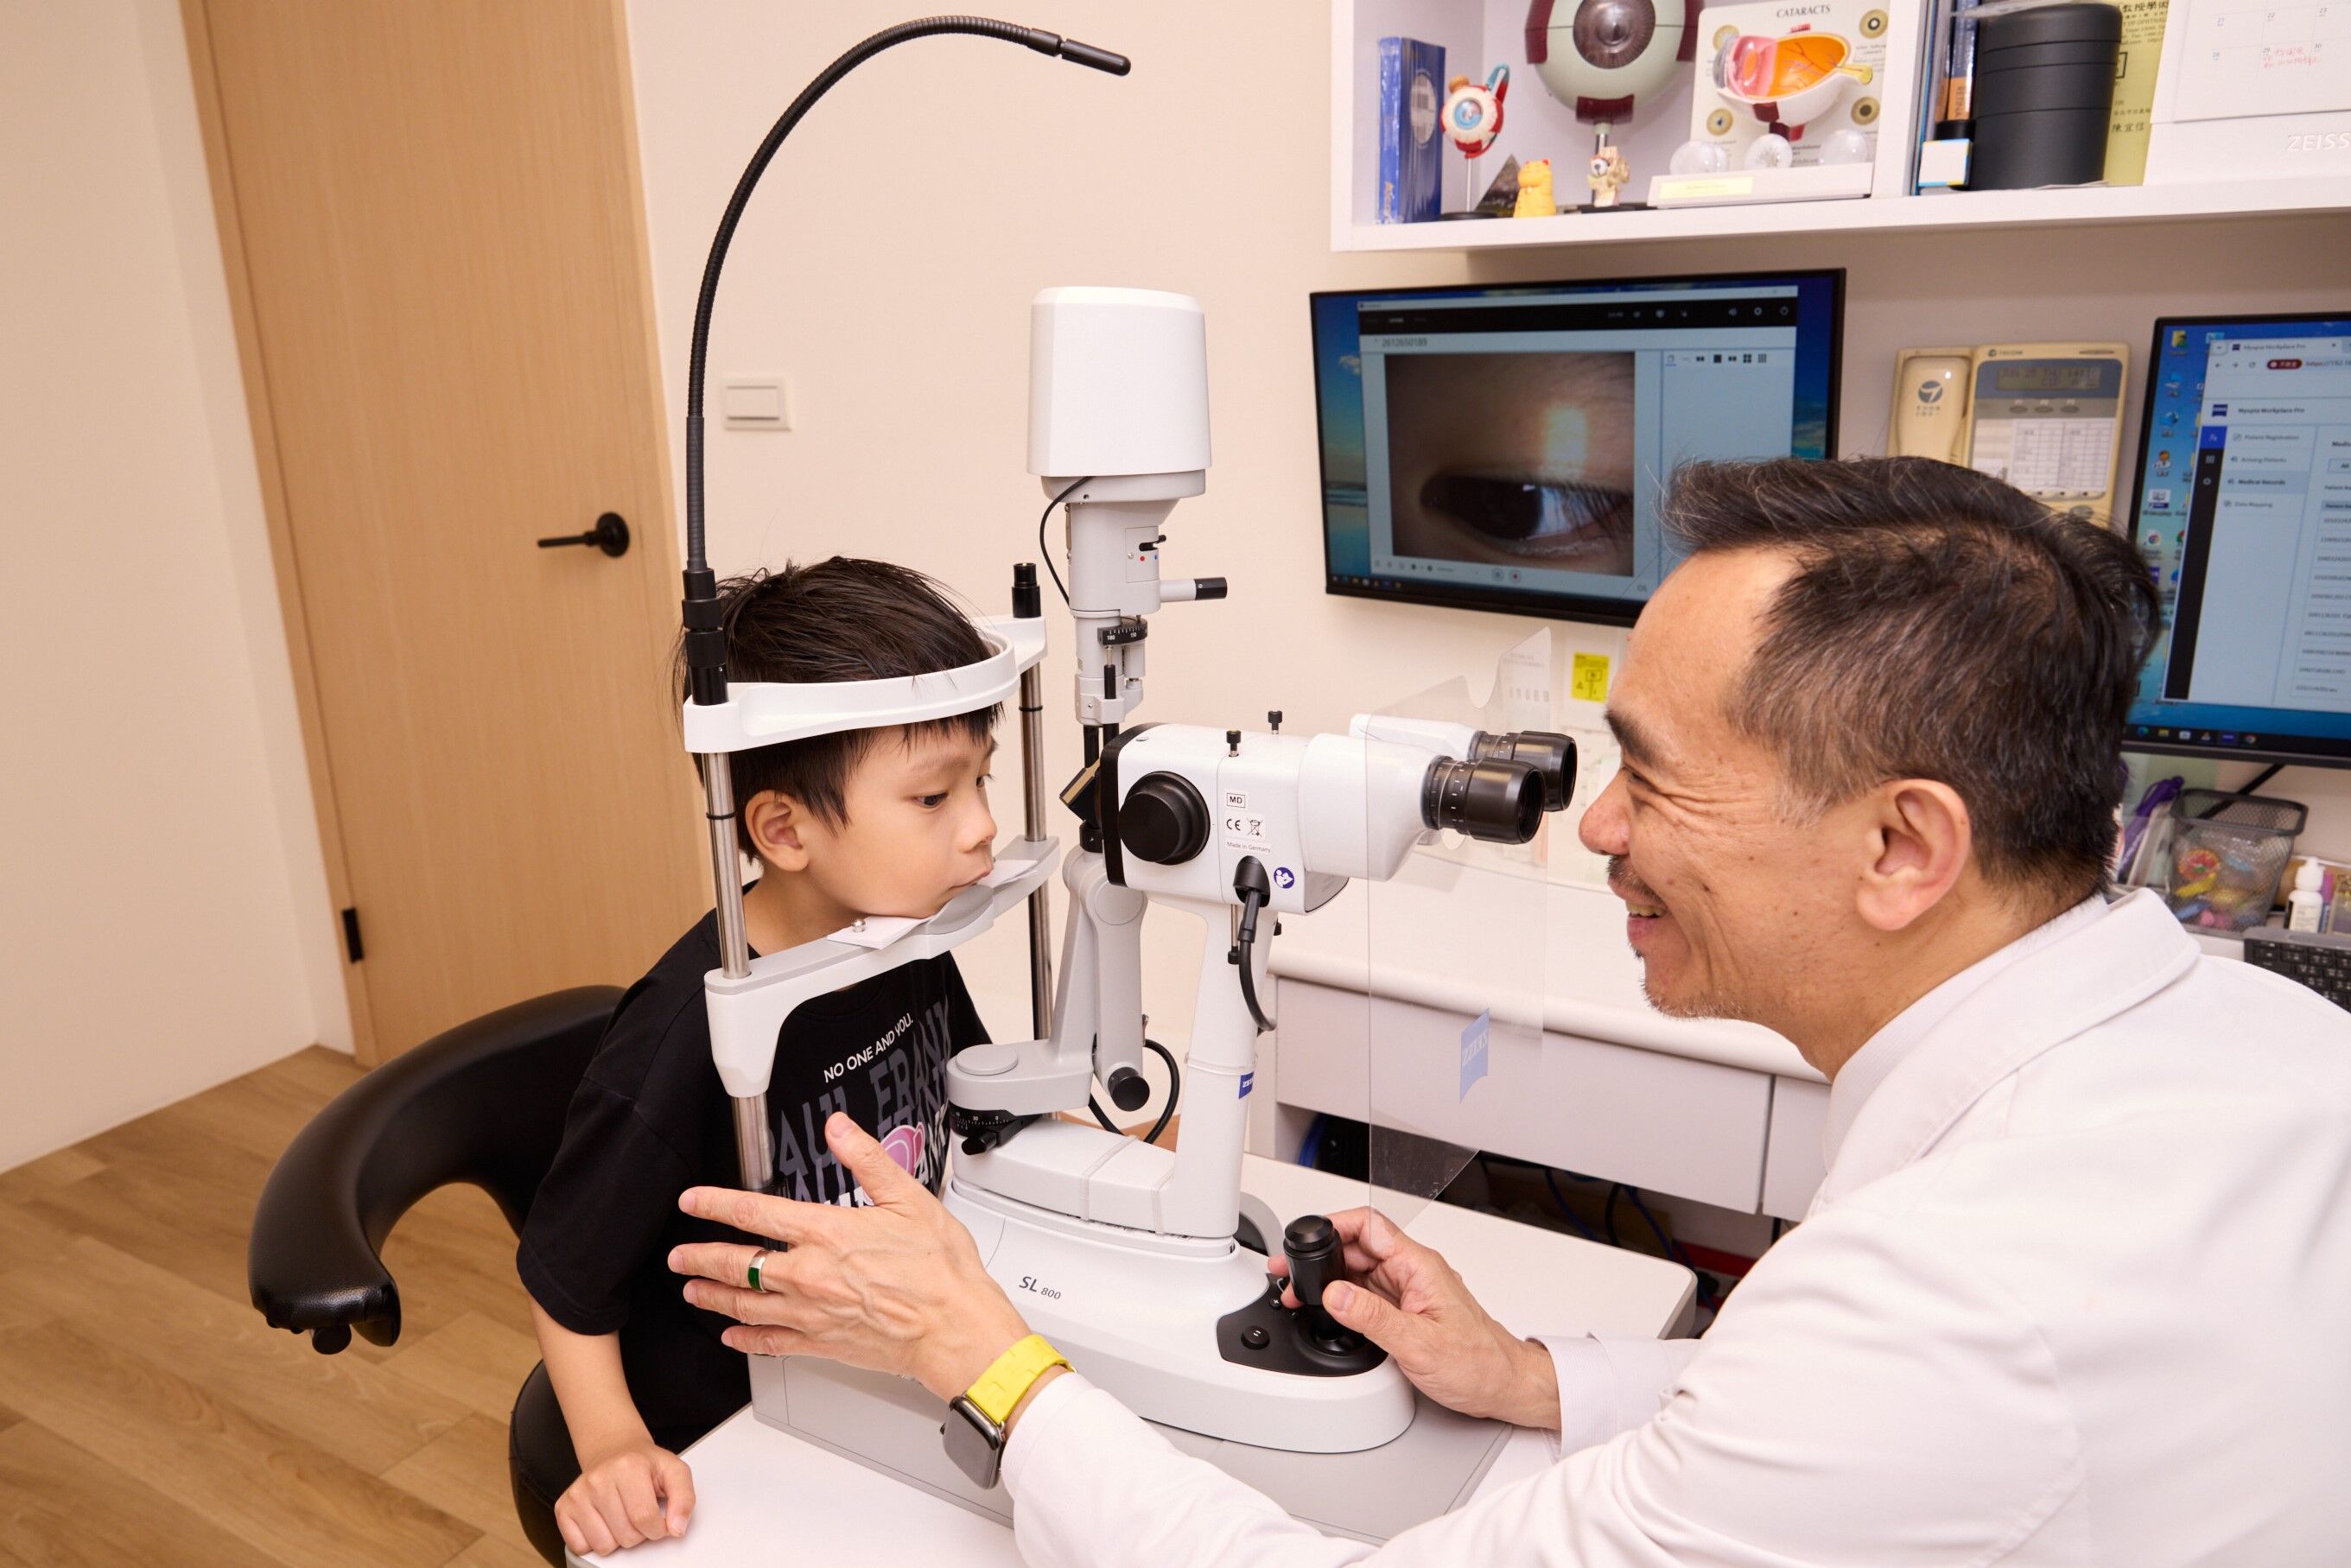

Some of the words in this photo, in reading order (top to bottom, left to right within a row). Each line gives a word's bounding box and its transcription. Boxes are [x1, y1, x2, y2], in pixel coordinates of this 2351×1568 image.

[1776, 4, 1831, 18] CATARACTS
[2287, 131, 2351, 152] ZEISS
[1230, 796, 1242, 804] MD
[1226, 818, 1241, 831] CE
[1248, 844, 1271, 854] Germany
[823, 1062, 844, 1083] NO
[846, 1046, 874, 1071] ONE
[875, 1030, 896, 1056] AND
[895, 1013, 914, 1038] YOU.
[1019, 1276, 1038, 1292] SL
[1040, 1287, 1062, 1300] 800
